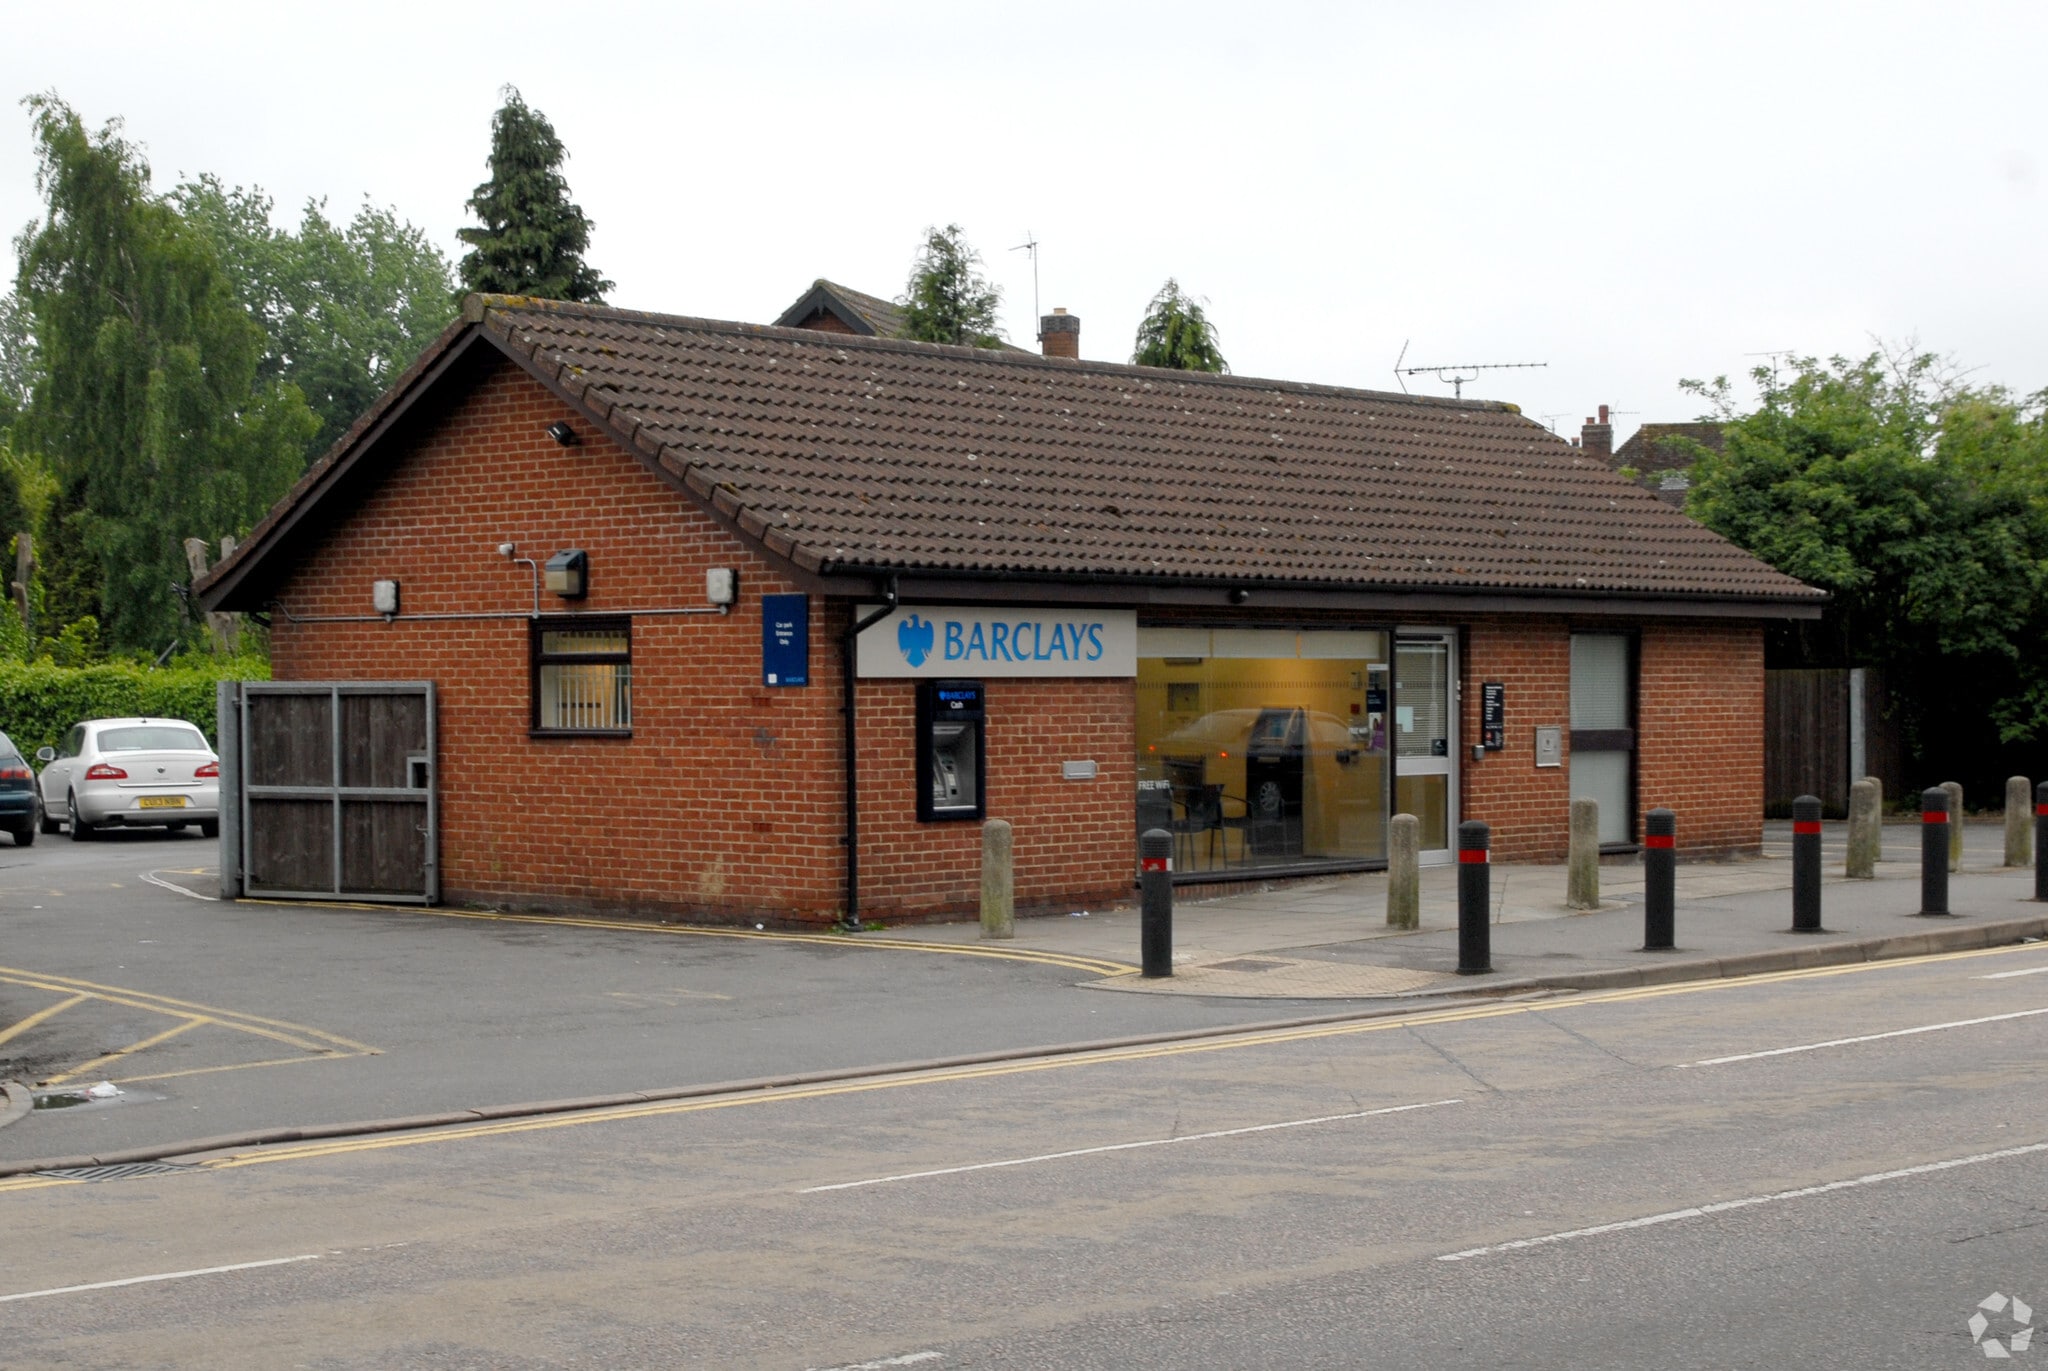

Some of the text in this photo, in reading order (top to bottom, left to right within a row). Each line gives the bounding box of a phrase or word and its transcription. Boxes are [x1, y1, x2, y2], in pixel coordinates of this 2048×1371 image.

[943, 621, 1104, 662] BARCLAYS
[944, 690, 977, 700] BARCLAYS
[1138, 780, 1155, 791] FREE
